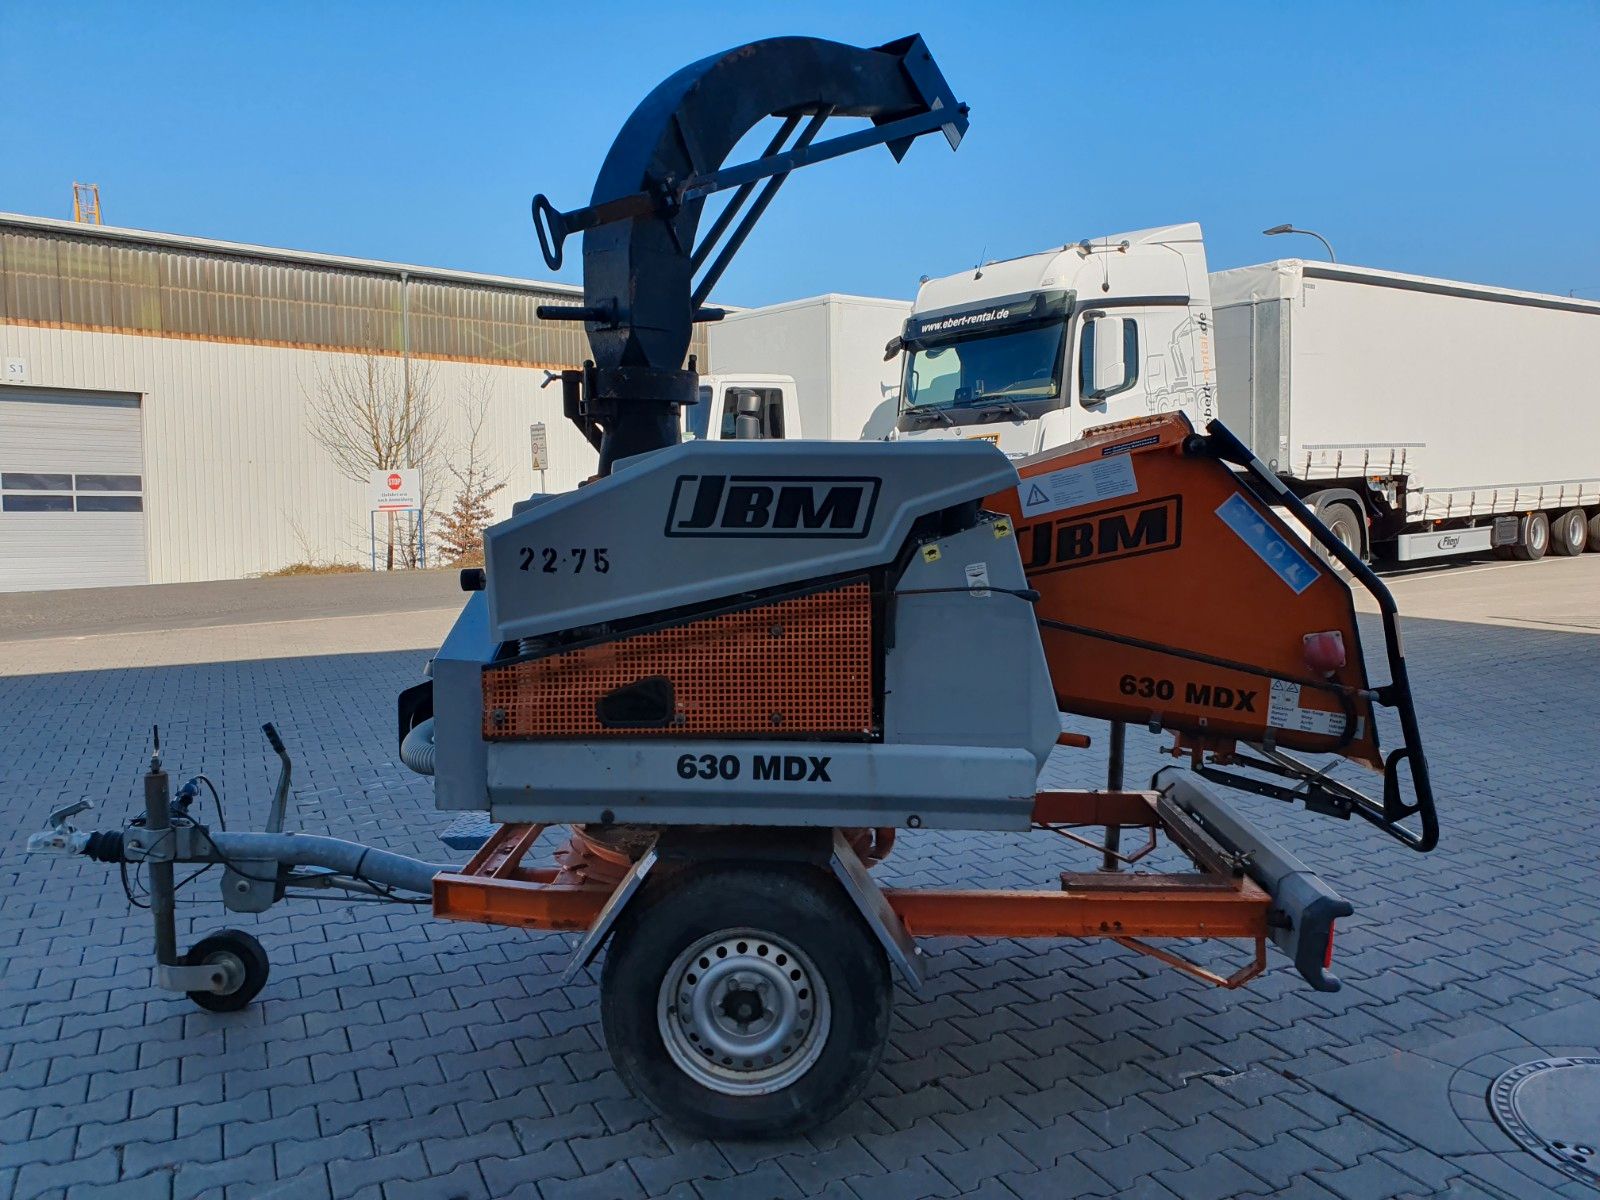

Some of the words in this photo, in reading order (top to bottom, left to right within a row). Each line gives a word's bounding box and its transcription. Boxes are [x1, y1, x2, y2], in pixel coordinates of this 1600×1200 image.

[921, 308, 1009, 333] www.ebert-rental.de
[387, 477, 402, 486] STOP
[677, 474, 865, 529] JBM
[1023, 504, 1168, 568] JBM
[1119, 674, 1175, 701] 630
[1184, 682, 1259, 713] MDX
[676, 754, 741, 780] 630
[752, 755, 832, 782] MDX
